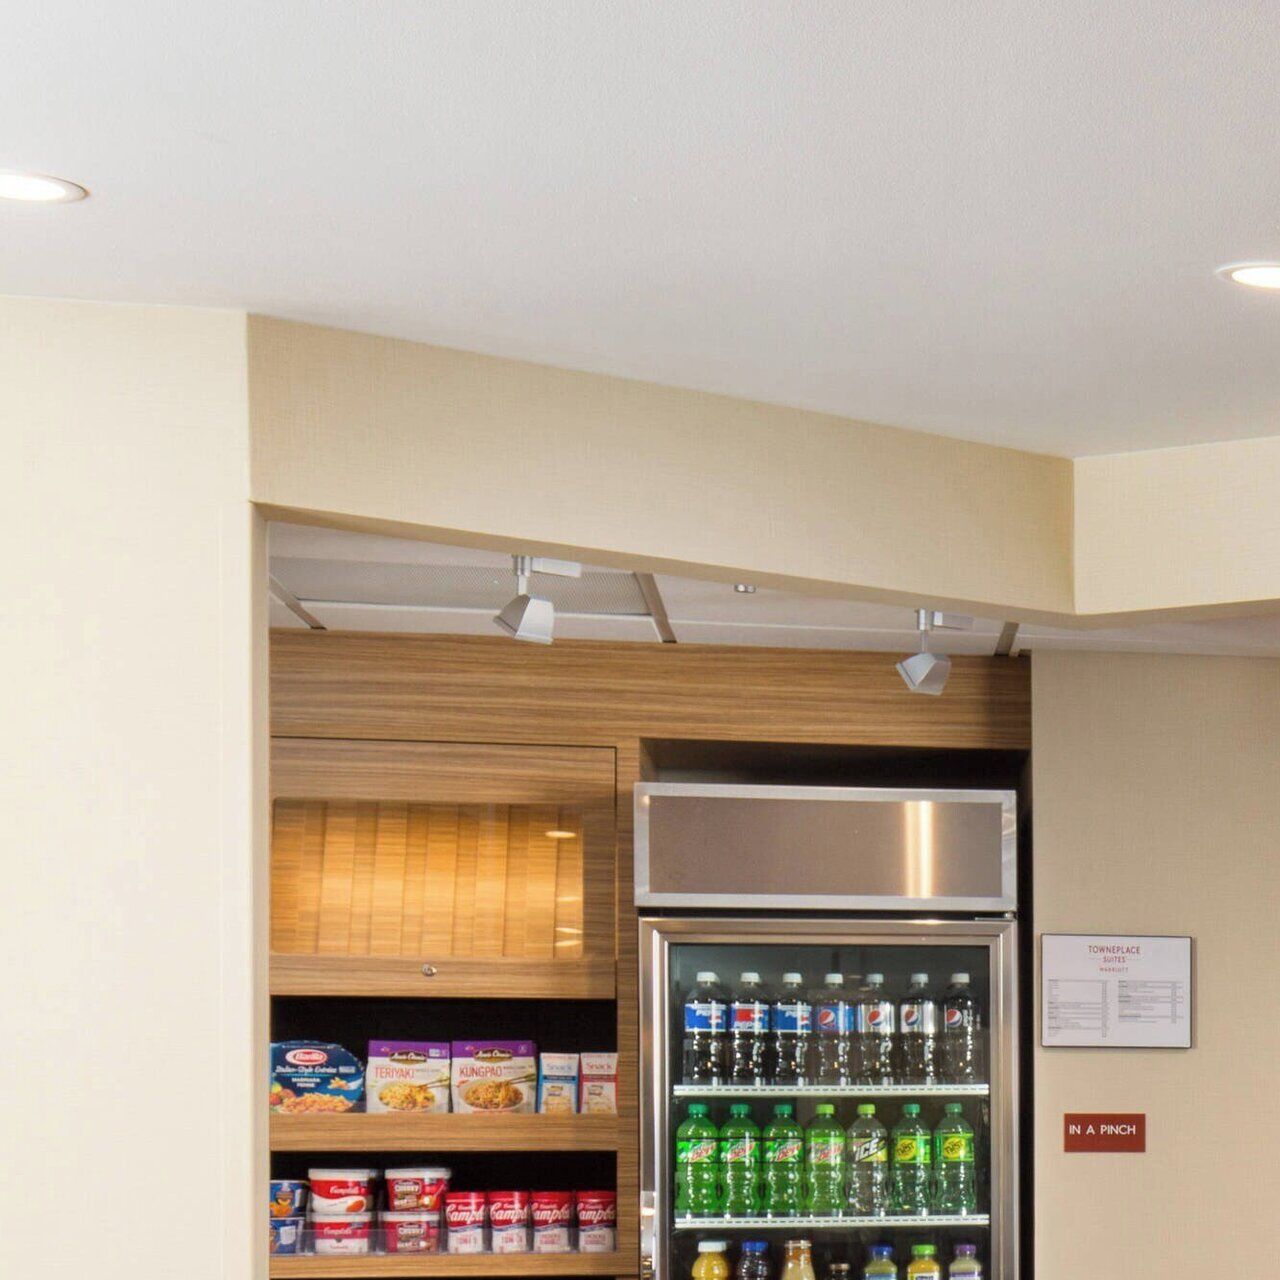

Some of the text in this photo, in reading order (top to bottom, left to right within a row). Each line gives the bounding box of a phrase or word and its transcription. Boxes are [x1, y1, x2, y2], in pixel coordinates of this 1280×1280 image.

[1088, 945, 1141, 955] TOWNEPLACE
[1069, 1124, 1136, 1135] IN A PINCH
